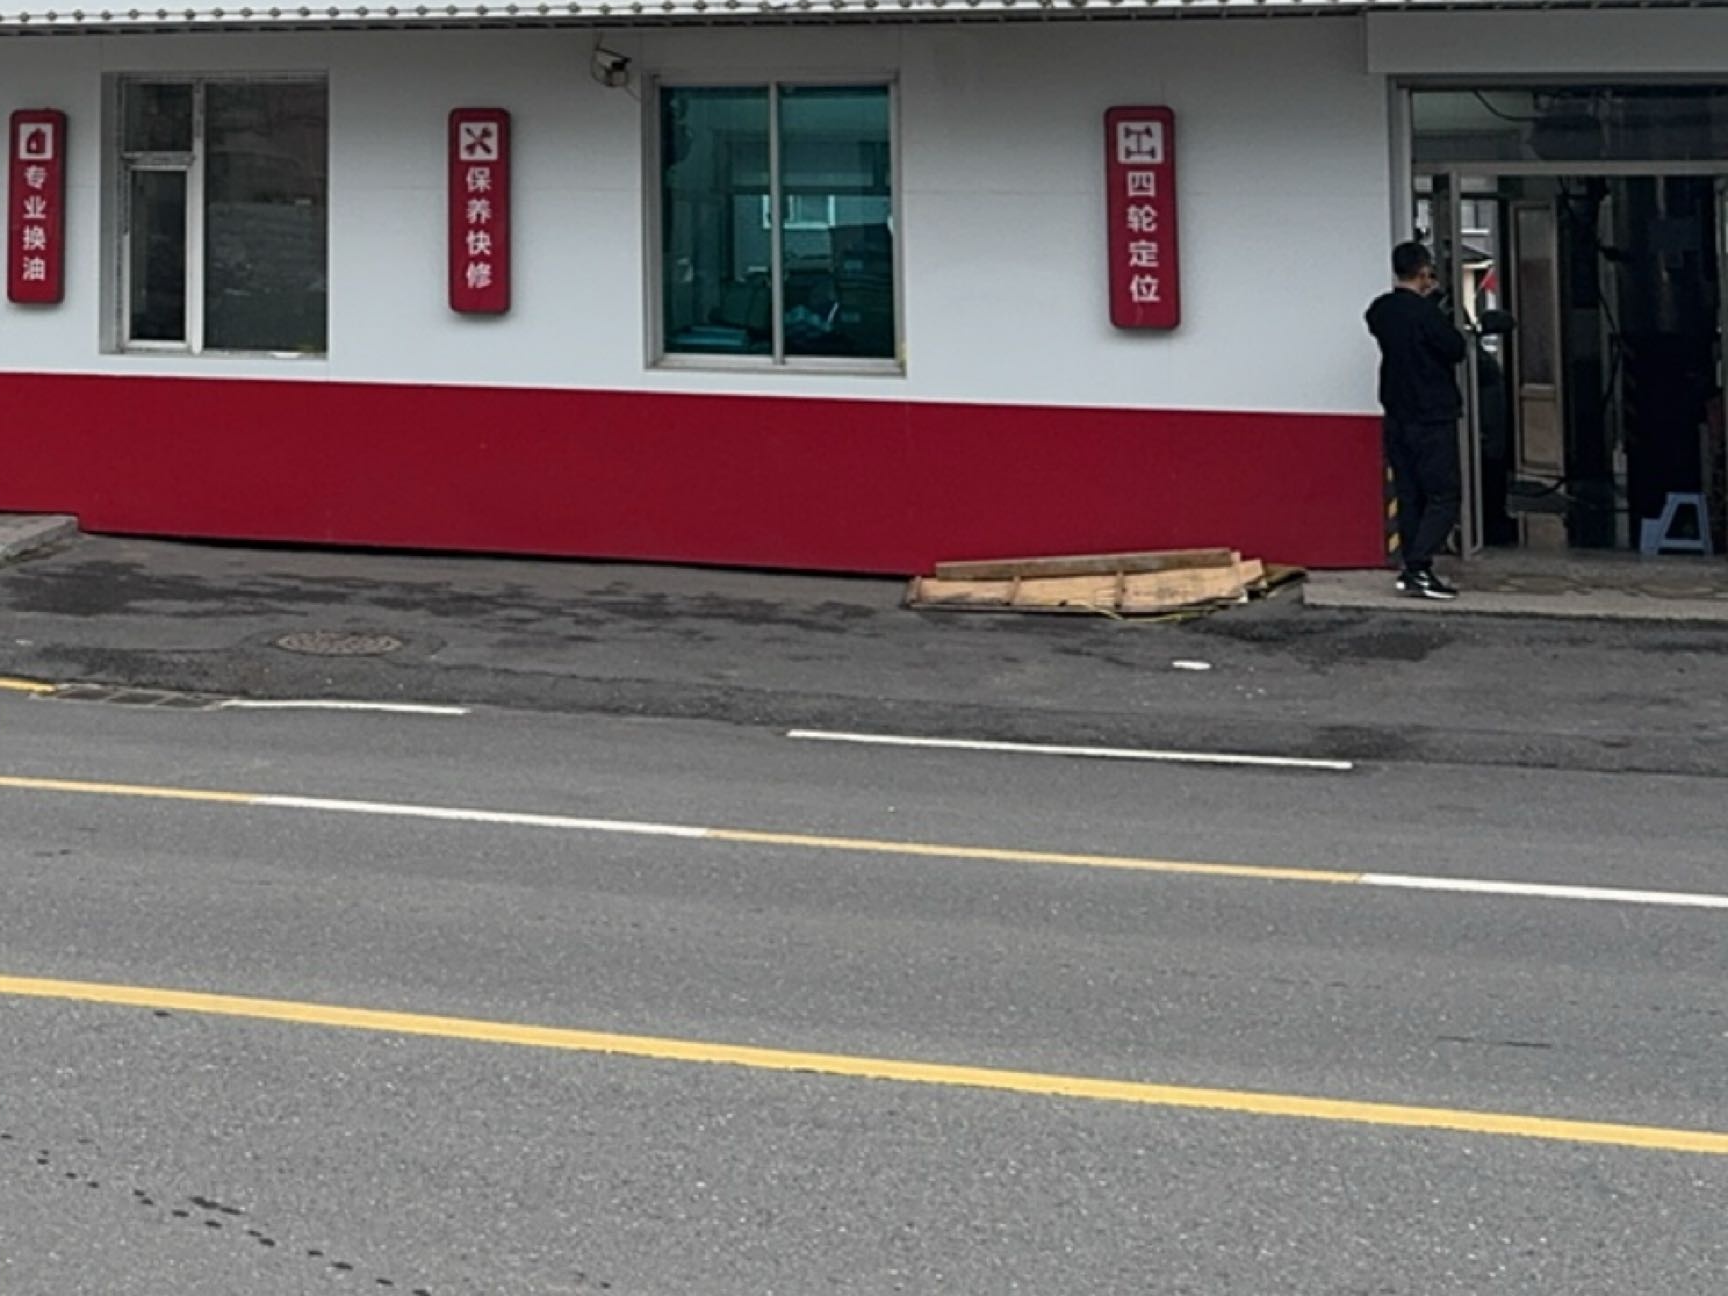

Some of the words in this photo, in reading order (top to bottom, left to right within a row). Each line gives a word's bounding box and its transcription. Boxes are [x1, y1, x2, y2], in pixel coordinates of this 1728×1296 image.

[23, 165, 48, 281] 专业换油
[466, 166, 492, 289] 保养快修
[1127, 170, 1161, 303] 四轮定位
